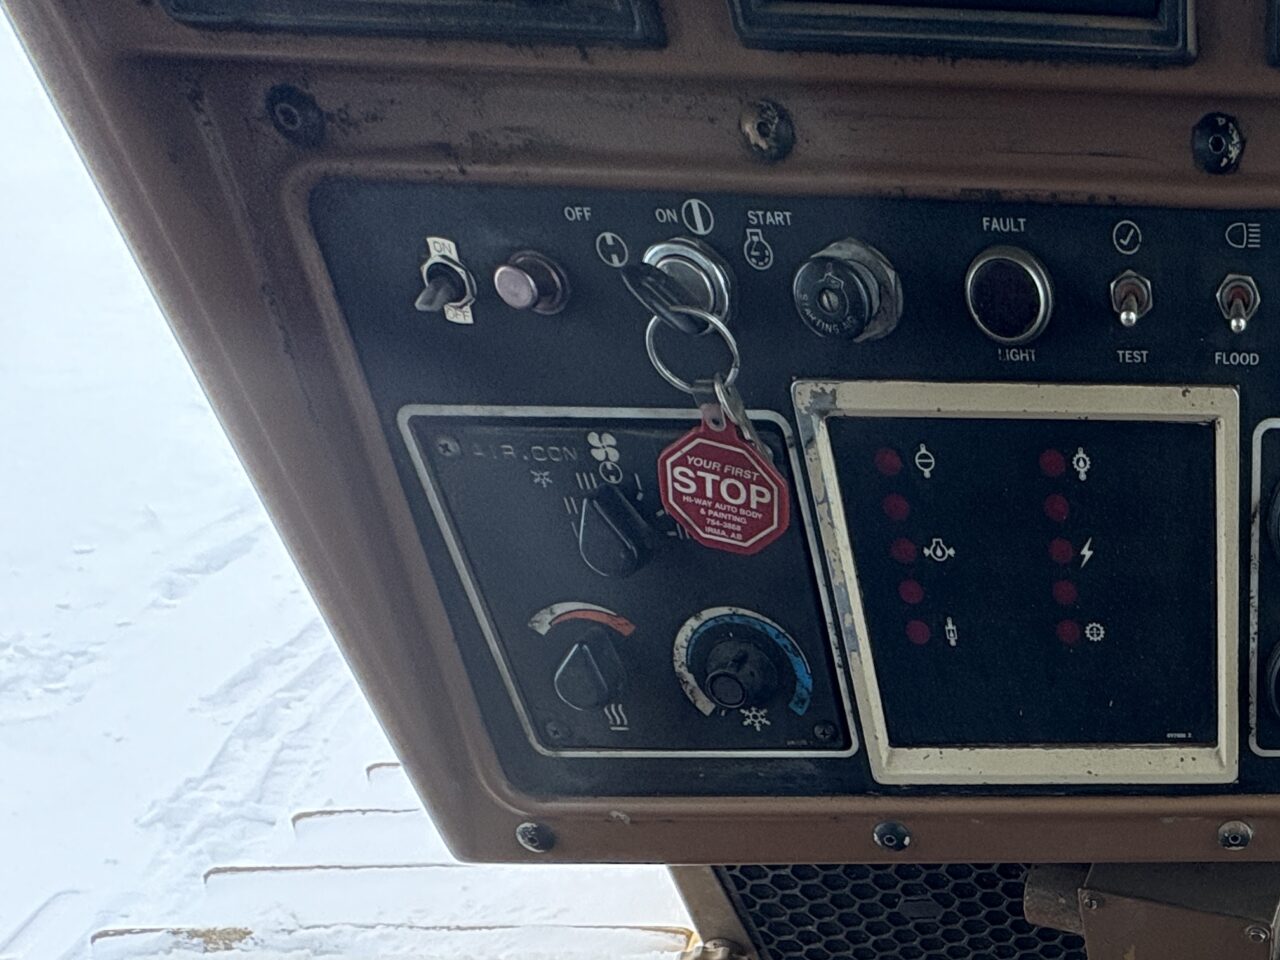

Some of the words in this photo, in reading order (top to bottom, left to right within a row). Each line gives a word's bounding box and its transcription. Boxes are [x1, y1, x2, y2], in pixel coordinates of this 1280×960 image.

[563, 206, 592, 222] OFF
[655, 208, 679, 224] ON
[747, 210, 792, 226] START
[982, 217, 1027, 233] FAULT
[432, 240, 453, 255] ON
[446, 307, 470, 321] OFF
[998, 348, 1036, 362] LIGHT
[1116, 350, 1149, 363] TEST
[1214, 352, 1260, 366] FLOOD
[686, 455, 721, 472] YOUR
[723, 464, 760, 481] FIRST
[672, 466, 771, 509] STOP
[682, 495, 713, 508] HI-WAY
[714, 502, 738, 514] AUTO
[739, 508, 763, 519] BODY
[707, 509, 748, 525] PAINTING
